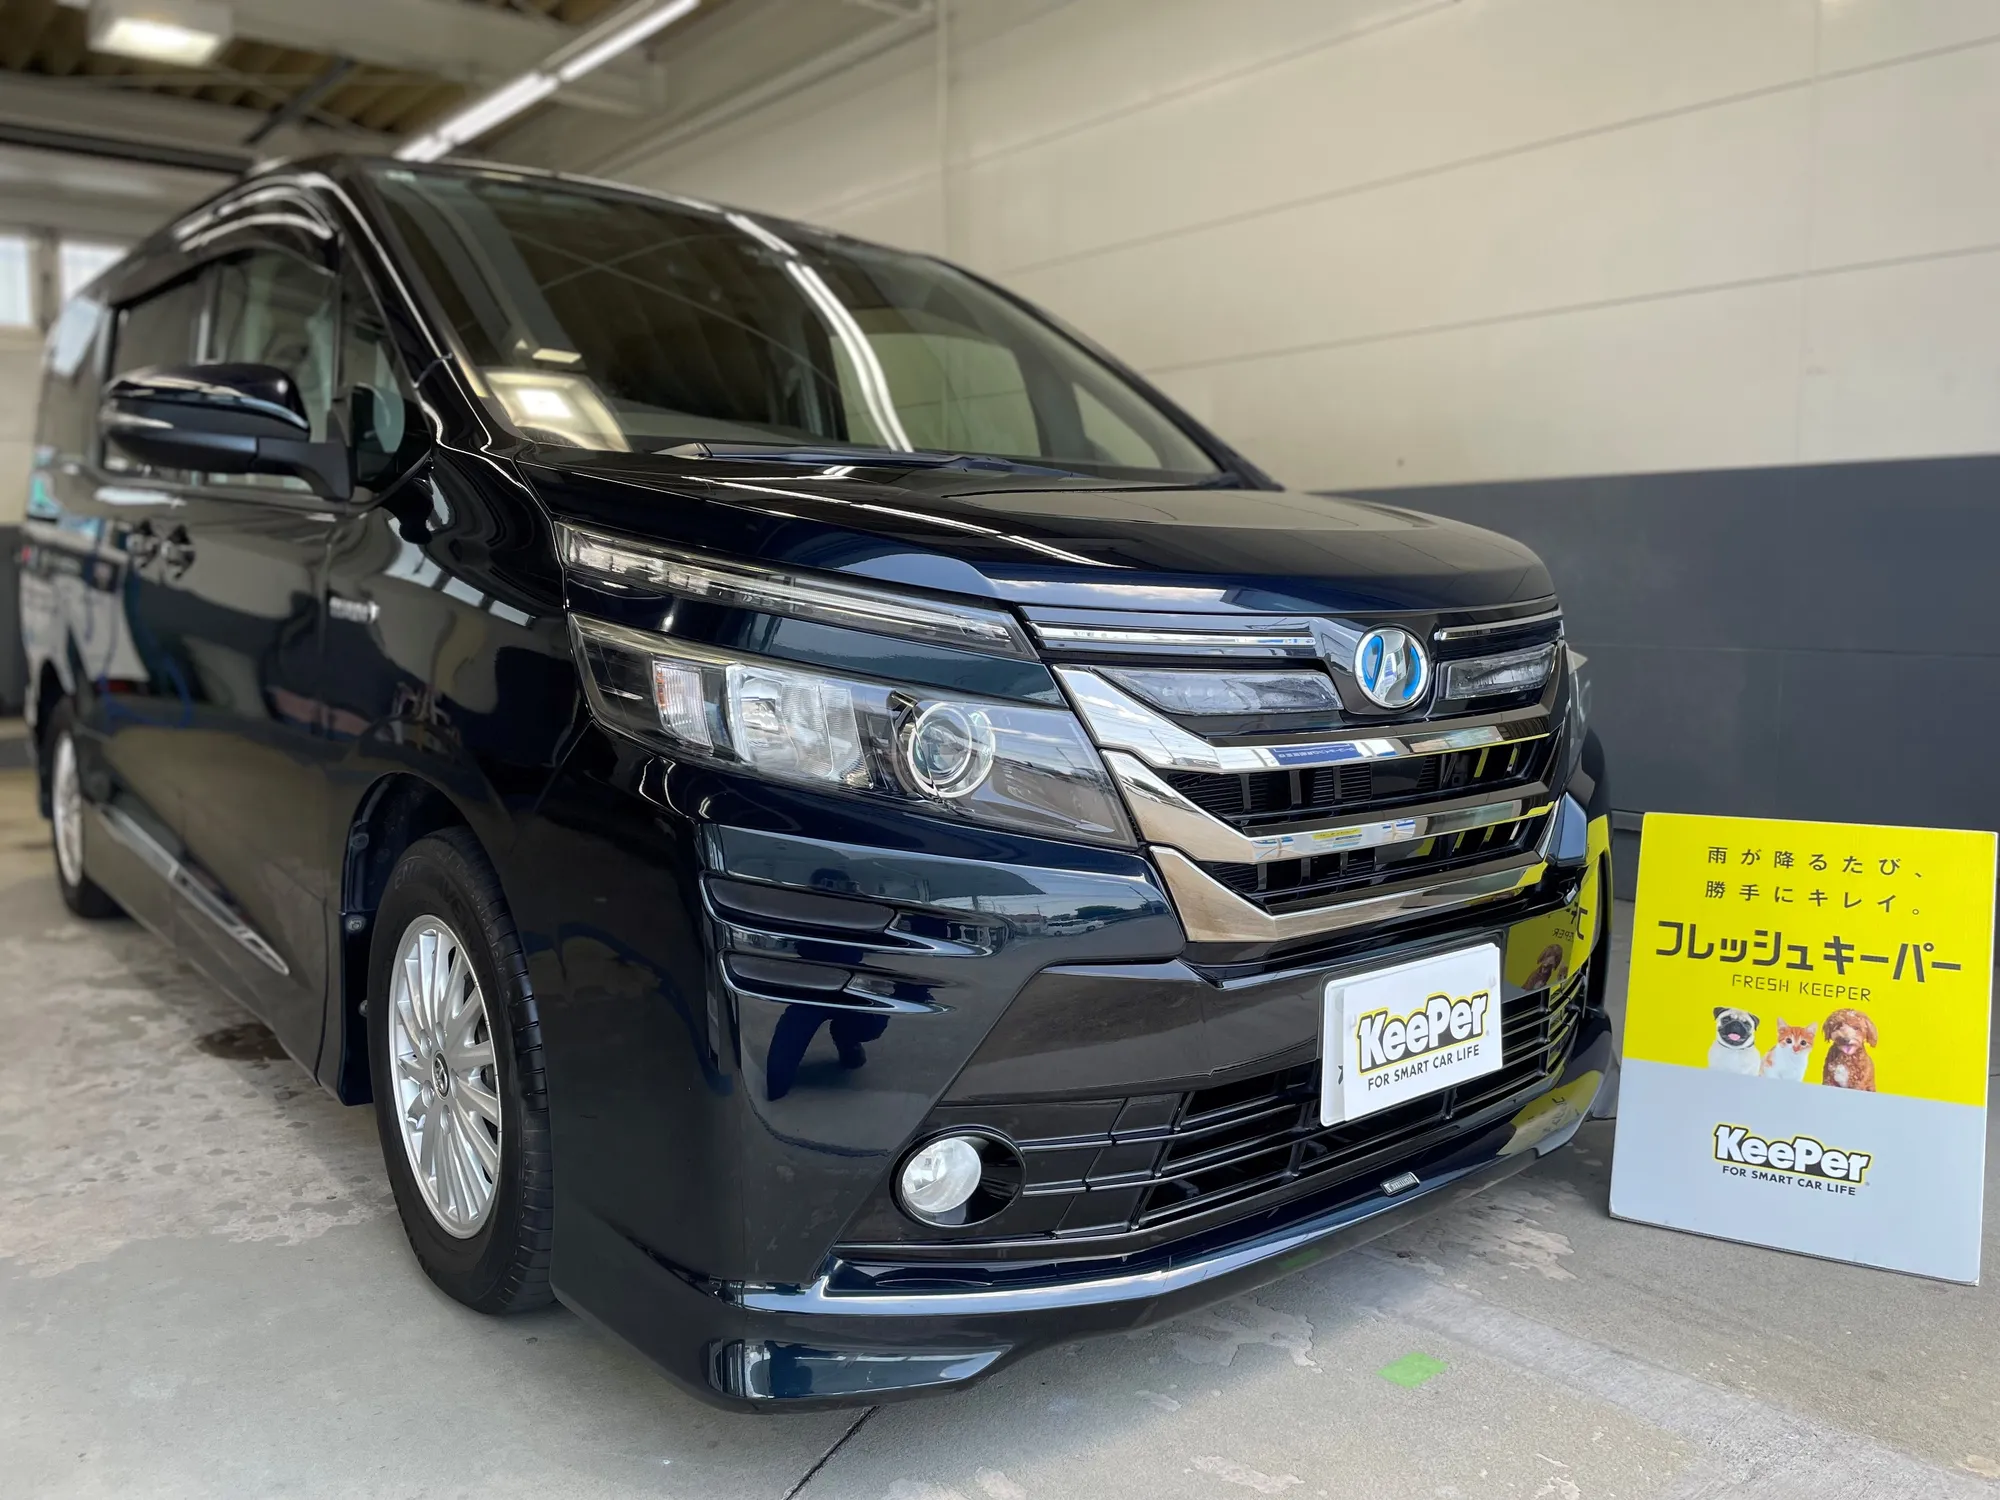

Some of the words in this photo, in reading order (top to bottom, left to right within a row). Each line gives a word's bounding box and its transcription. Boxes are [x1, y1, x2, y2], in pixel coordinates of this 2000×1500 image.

[1707, 845, 1922, 878] 雨が降るたび、
[1705, 880, 1920, 916] 勝手にキレイ。
[1655, 920, 1962, 983] フレッシュキーパー
[1731, 974, 1789, 993] FRESH
[1799, 982, 1871, 1002] KEEPER
[1357, 992, 1488, 1074] KeePer
[1367, 1073, 1390, 1091] FOR
[1394, 1060, 1430, 1082] SMART
[1432, 1052, 1453, 1069] CAR
[1456, 1044, 1480, 1062] LIFE
[1714, 1124, 1872, 1184] KeePer
[1722, 1165, 1747, 1178] FOR
[1751, 1170, 1793, 1185] SMART
[1797, 1178, 1823, 1191] CAR
[1826, 1183, 1856, 1196] LIFE
